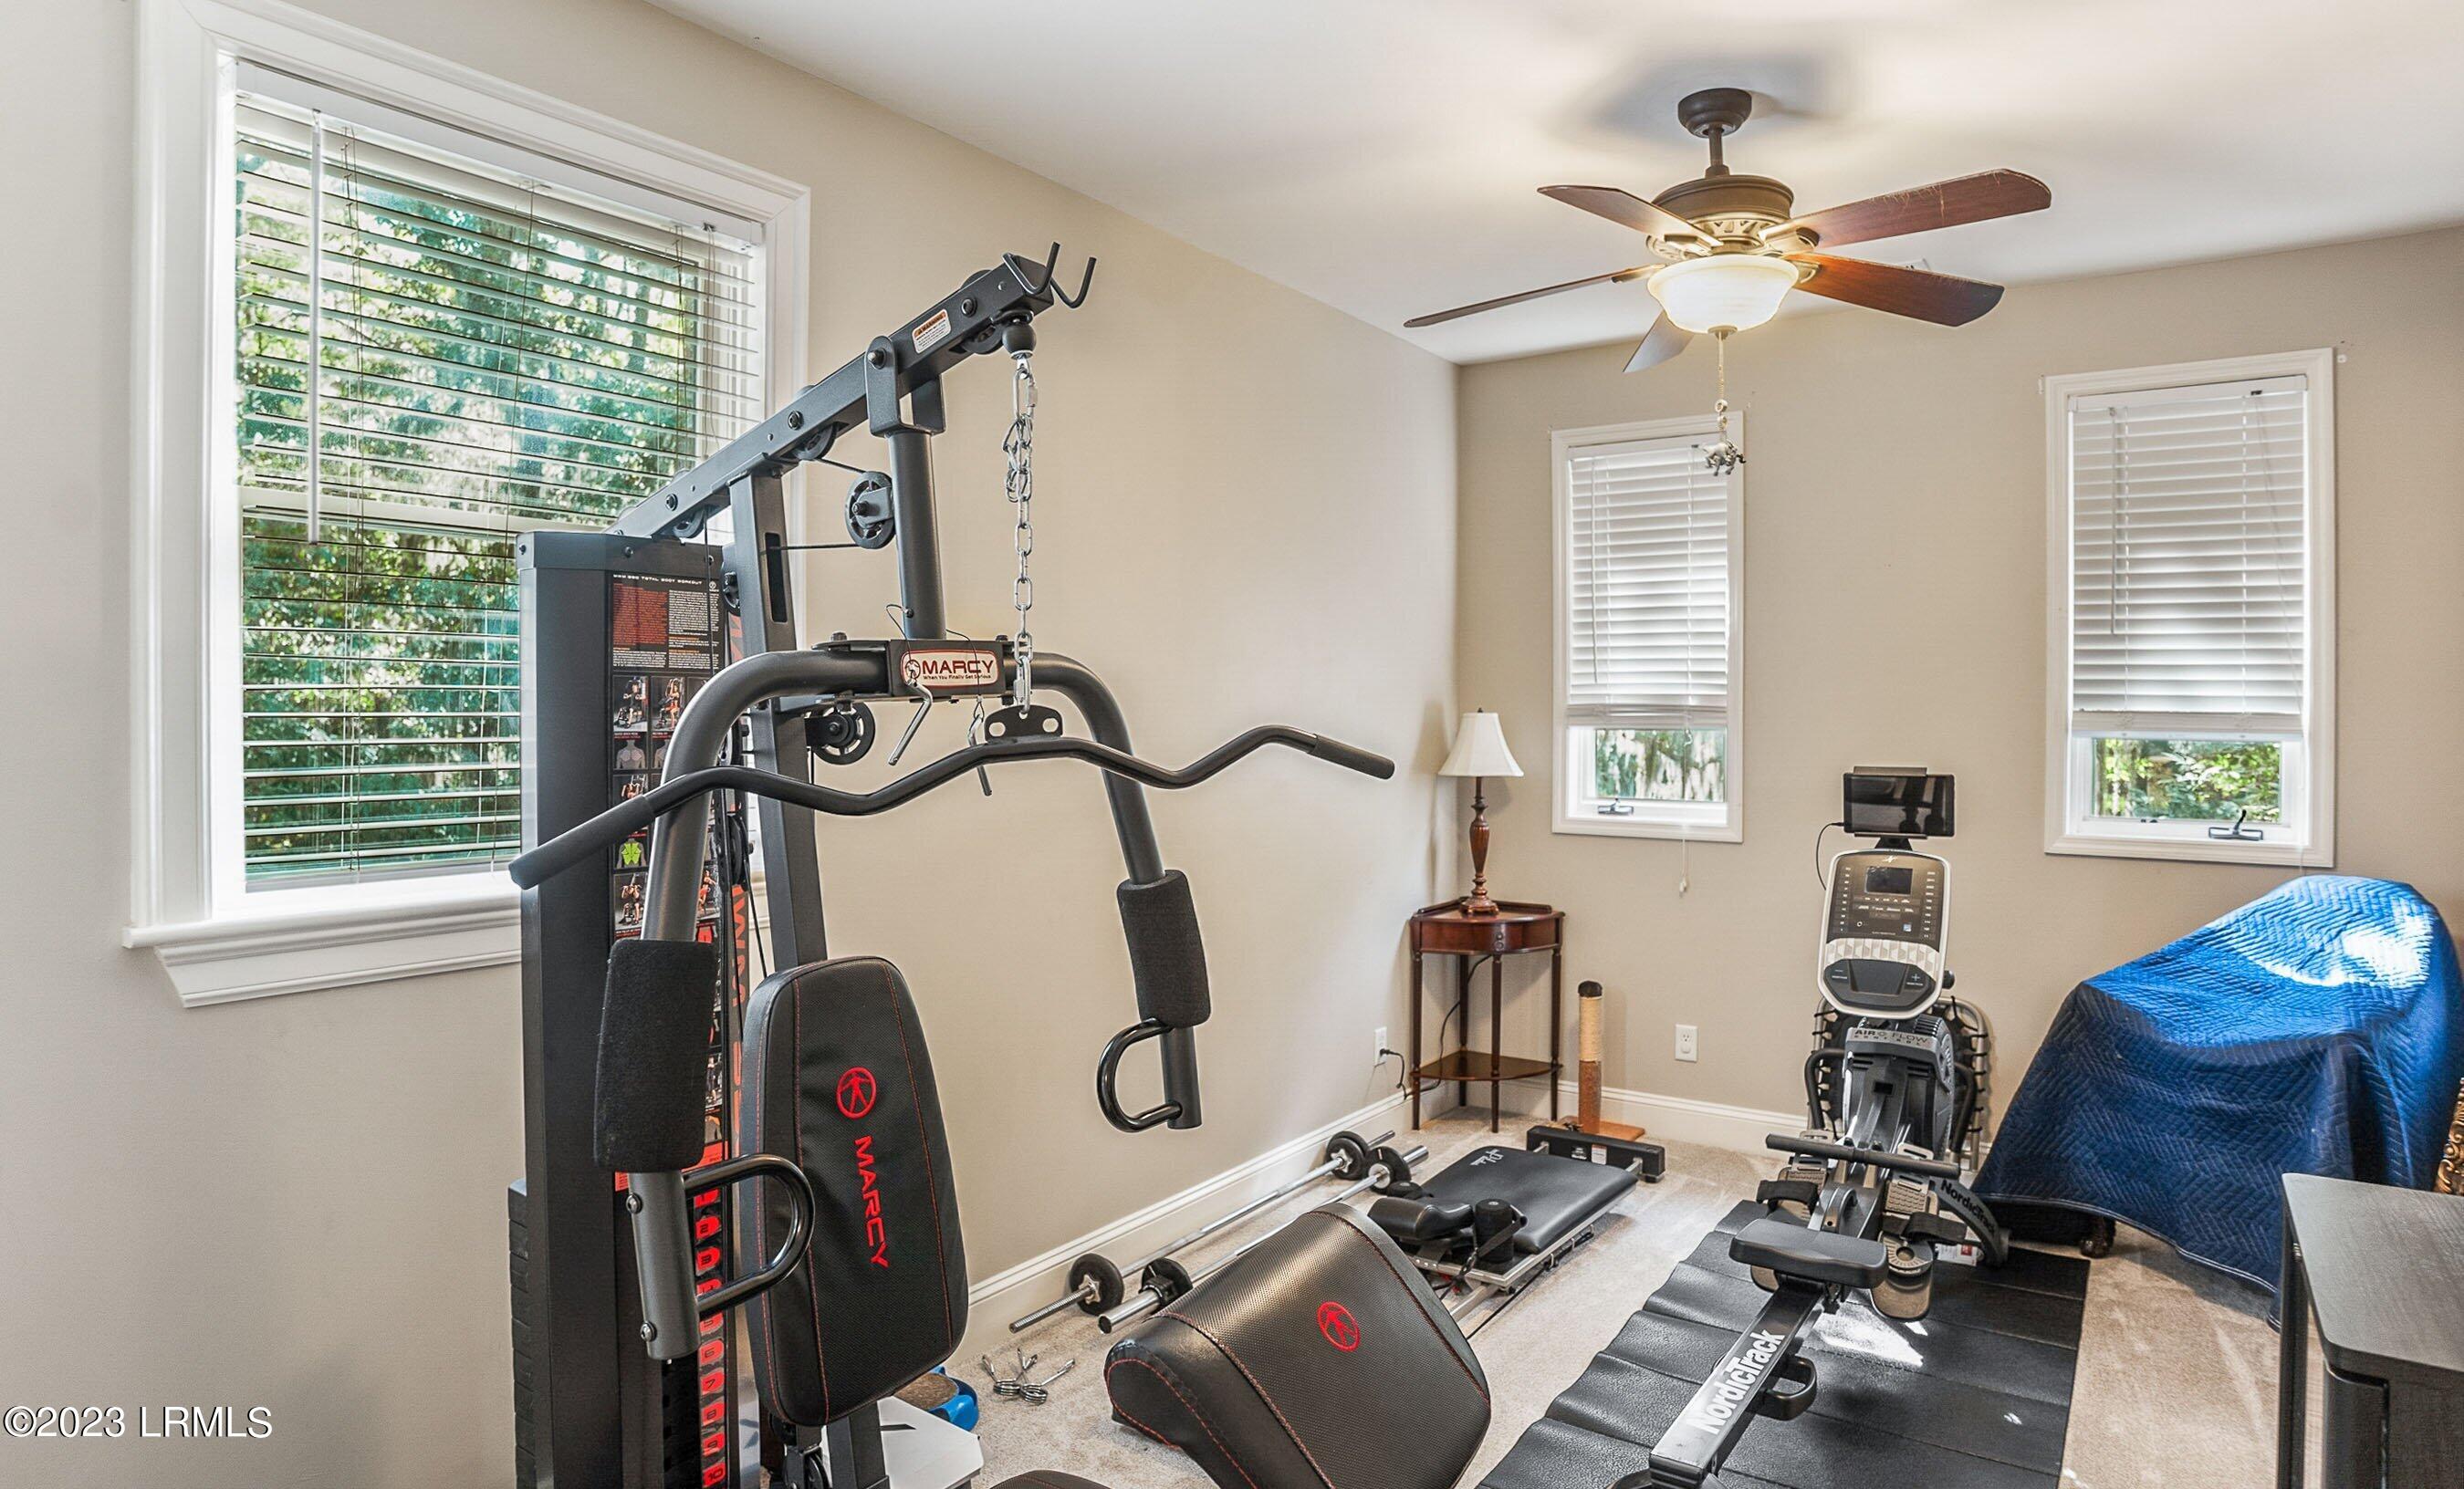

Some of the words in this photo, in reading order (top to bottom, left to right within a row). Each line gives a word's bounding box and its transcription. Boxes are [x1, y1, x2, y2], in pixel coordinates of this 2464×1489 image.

[923, 660, 993, 674] MARCY
[1892, 1032, 1928, 1043] FLOW
[854, 1135, 890, 1268] MARCY
[1687, 1329, 1786, 1435] NordicTrack
[708, 1467, 724, 1483] 10
